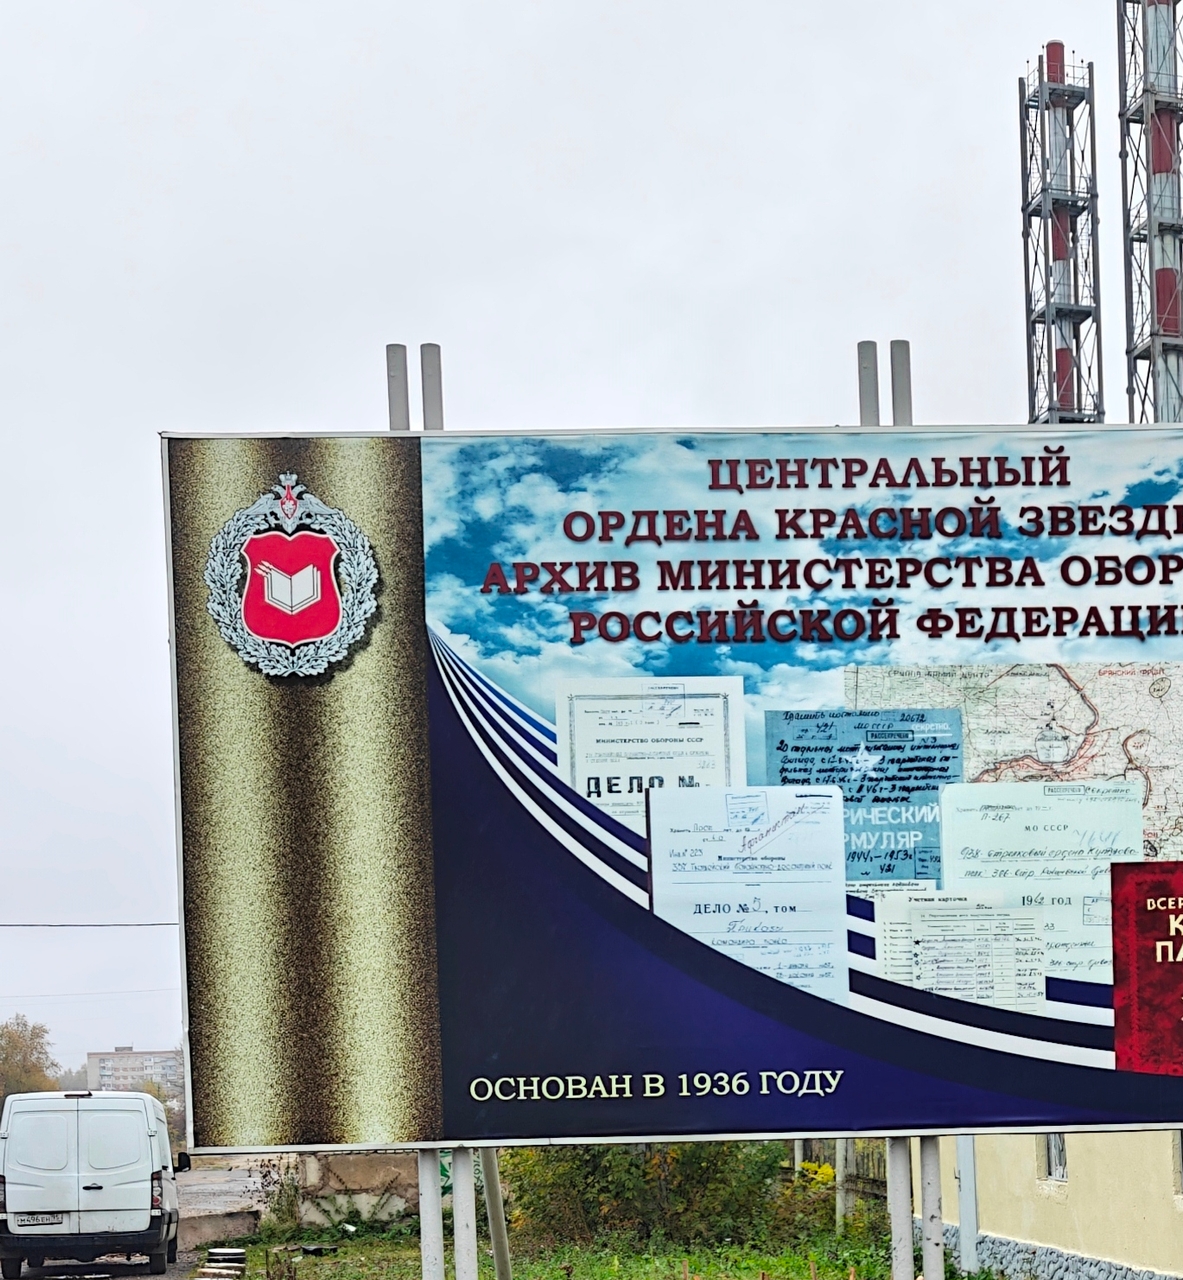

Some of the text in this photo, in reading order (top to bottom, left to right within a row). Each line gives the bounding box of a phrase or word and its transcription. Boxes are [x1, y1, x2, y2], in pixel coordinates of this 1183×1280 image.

[708, 446, 1071, 493] ЦЕНТРАЛЬНЫЙ
[562, 508, 760, 546] ОРДЕНА
[775, 497, 999, 541] КРАСНОЙ
[480, 560, 640, 595] АРХИВ
[656, 556, 1044, 593] МИНИСТЕРСТВА
[569, 598, 901, 645] РОССИЙСКОЙ
[1044, 824, 1069, 832] СССР
[693, 903, 731, 915] ДЕЛО
[773, 905, 797, 913] том
[1051, 897, 1073, 906] год
[468, 1069, 844, 1102] ОСНОВАН В 1936 ГОДУ
